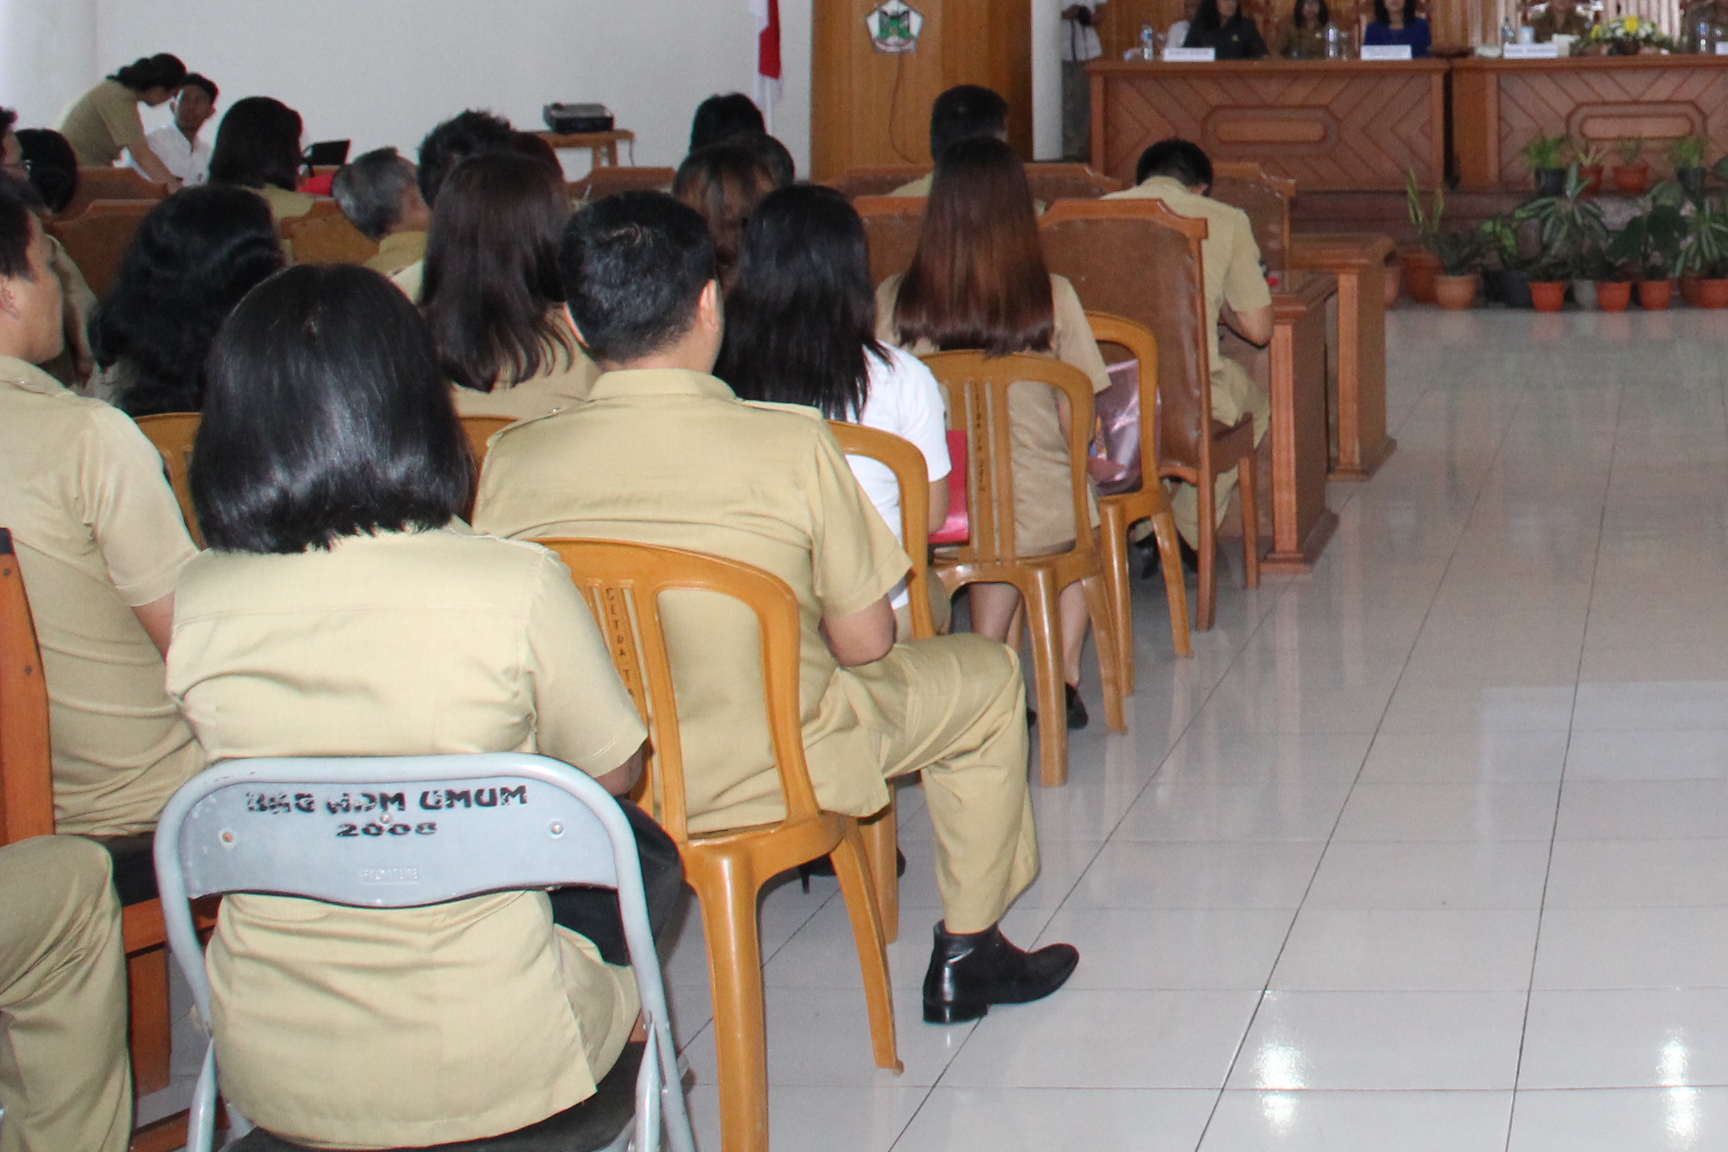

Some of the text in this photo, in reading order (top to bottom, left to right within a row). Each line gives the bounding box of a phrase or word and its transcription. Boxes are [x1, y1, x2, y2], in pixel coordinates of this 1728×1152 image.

[605, 587, 627, 657] SETDA
[419, 785, 528, 810] UMUM
[336, 822, 438, 837] 2008
